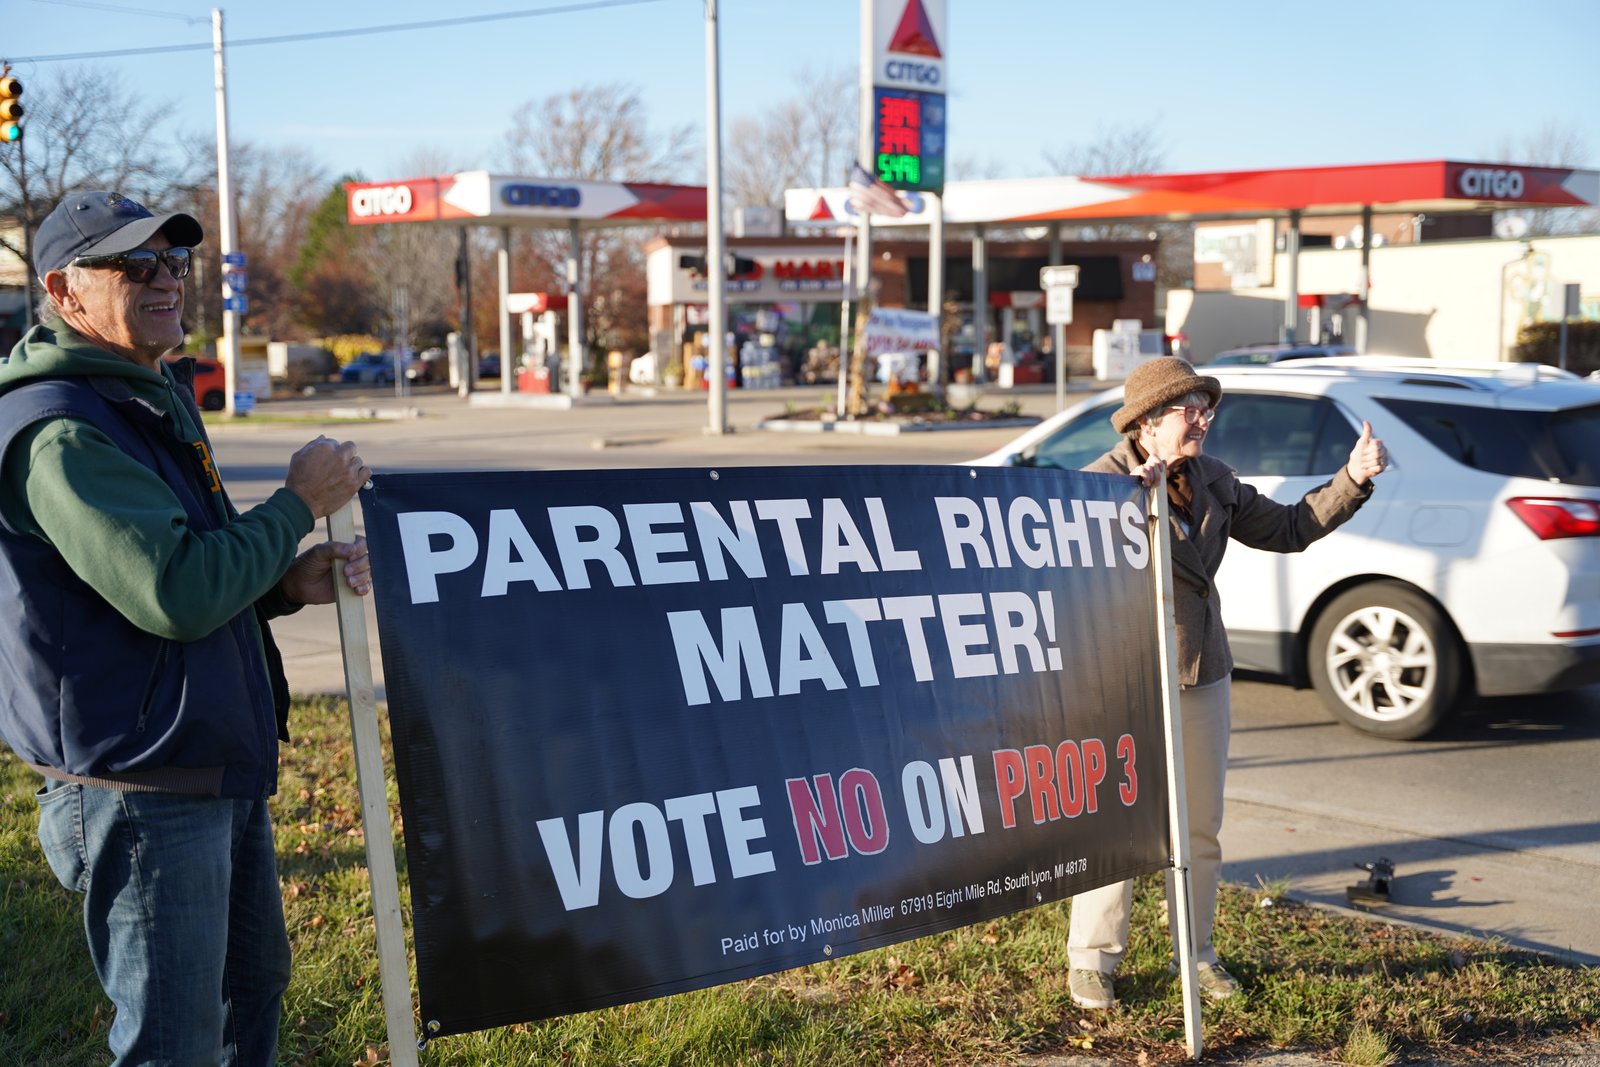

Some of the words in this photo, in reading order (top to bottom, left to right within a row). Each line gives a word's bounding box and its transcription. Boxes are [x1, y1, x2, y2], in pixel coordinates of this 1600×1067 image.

[885, 59, 940, 85] CITGO
[352, 185, 412, 217] CITGO
[1460, 168, 1524, 198] CITGO
[397, 497, 922, 604] PARENTAL
[934, 496, 1149, 570] RIGHTS
[666, 590, 1063, 706] MATTER!
[536, 785, 776, 911] VOTE
[785, 767, 890, 865] NO
[902, 755, 985, 845] ON
[991, 738, 1107, 830] PROP
[1117, 733, 1138, 807] 3
[721, 931, 759, 955] Paid
[763, 929, 785, 946] for
[788, 924, 807, 942] by
[810, 913, 860, 935] Monica
[861, 904, 895, 924] Miller
[900, 894, 934, 916] 67919
[936, 888, 963, 909] Eight
[964, 884, 985, 901] Mile
[987, 879, 1002, 896] Rd,
[1004, 873, 1030, 891] South
[1031, 870, 1053, 887] Lyon,
[1054, 863, 1064, 880] MI
[1065, 857, 1088, 876] 48178
